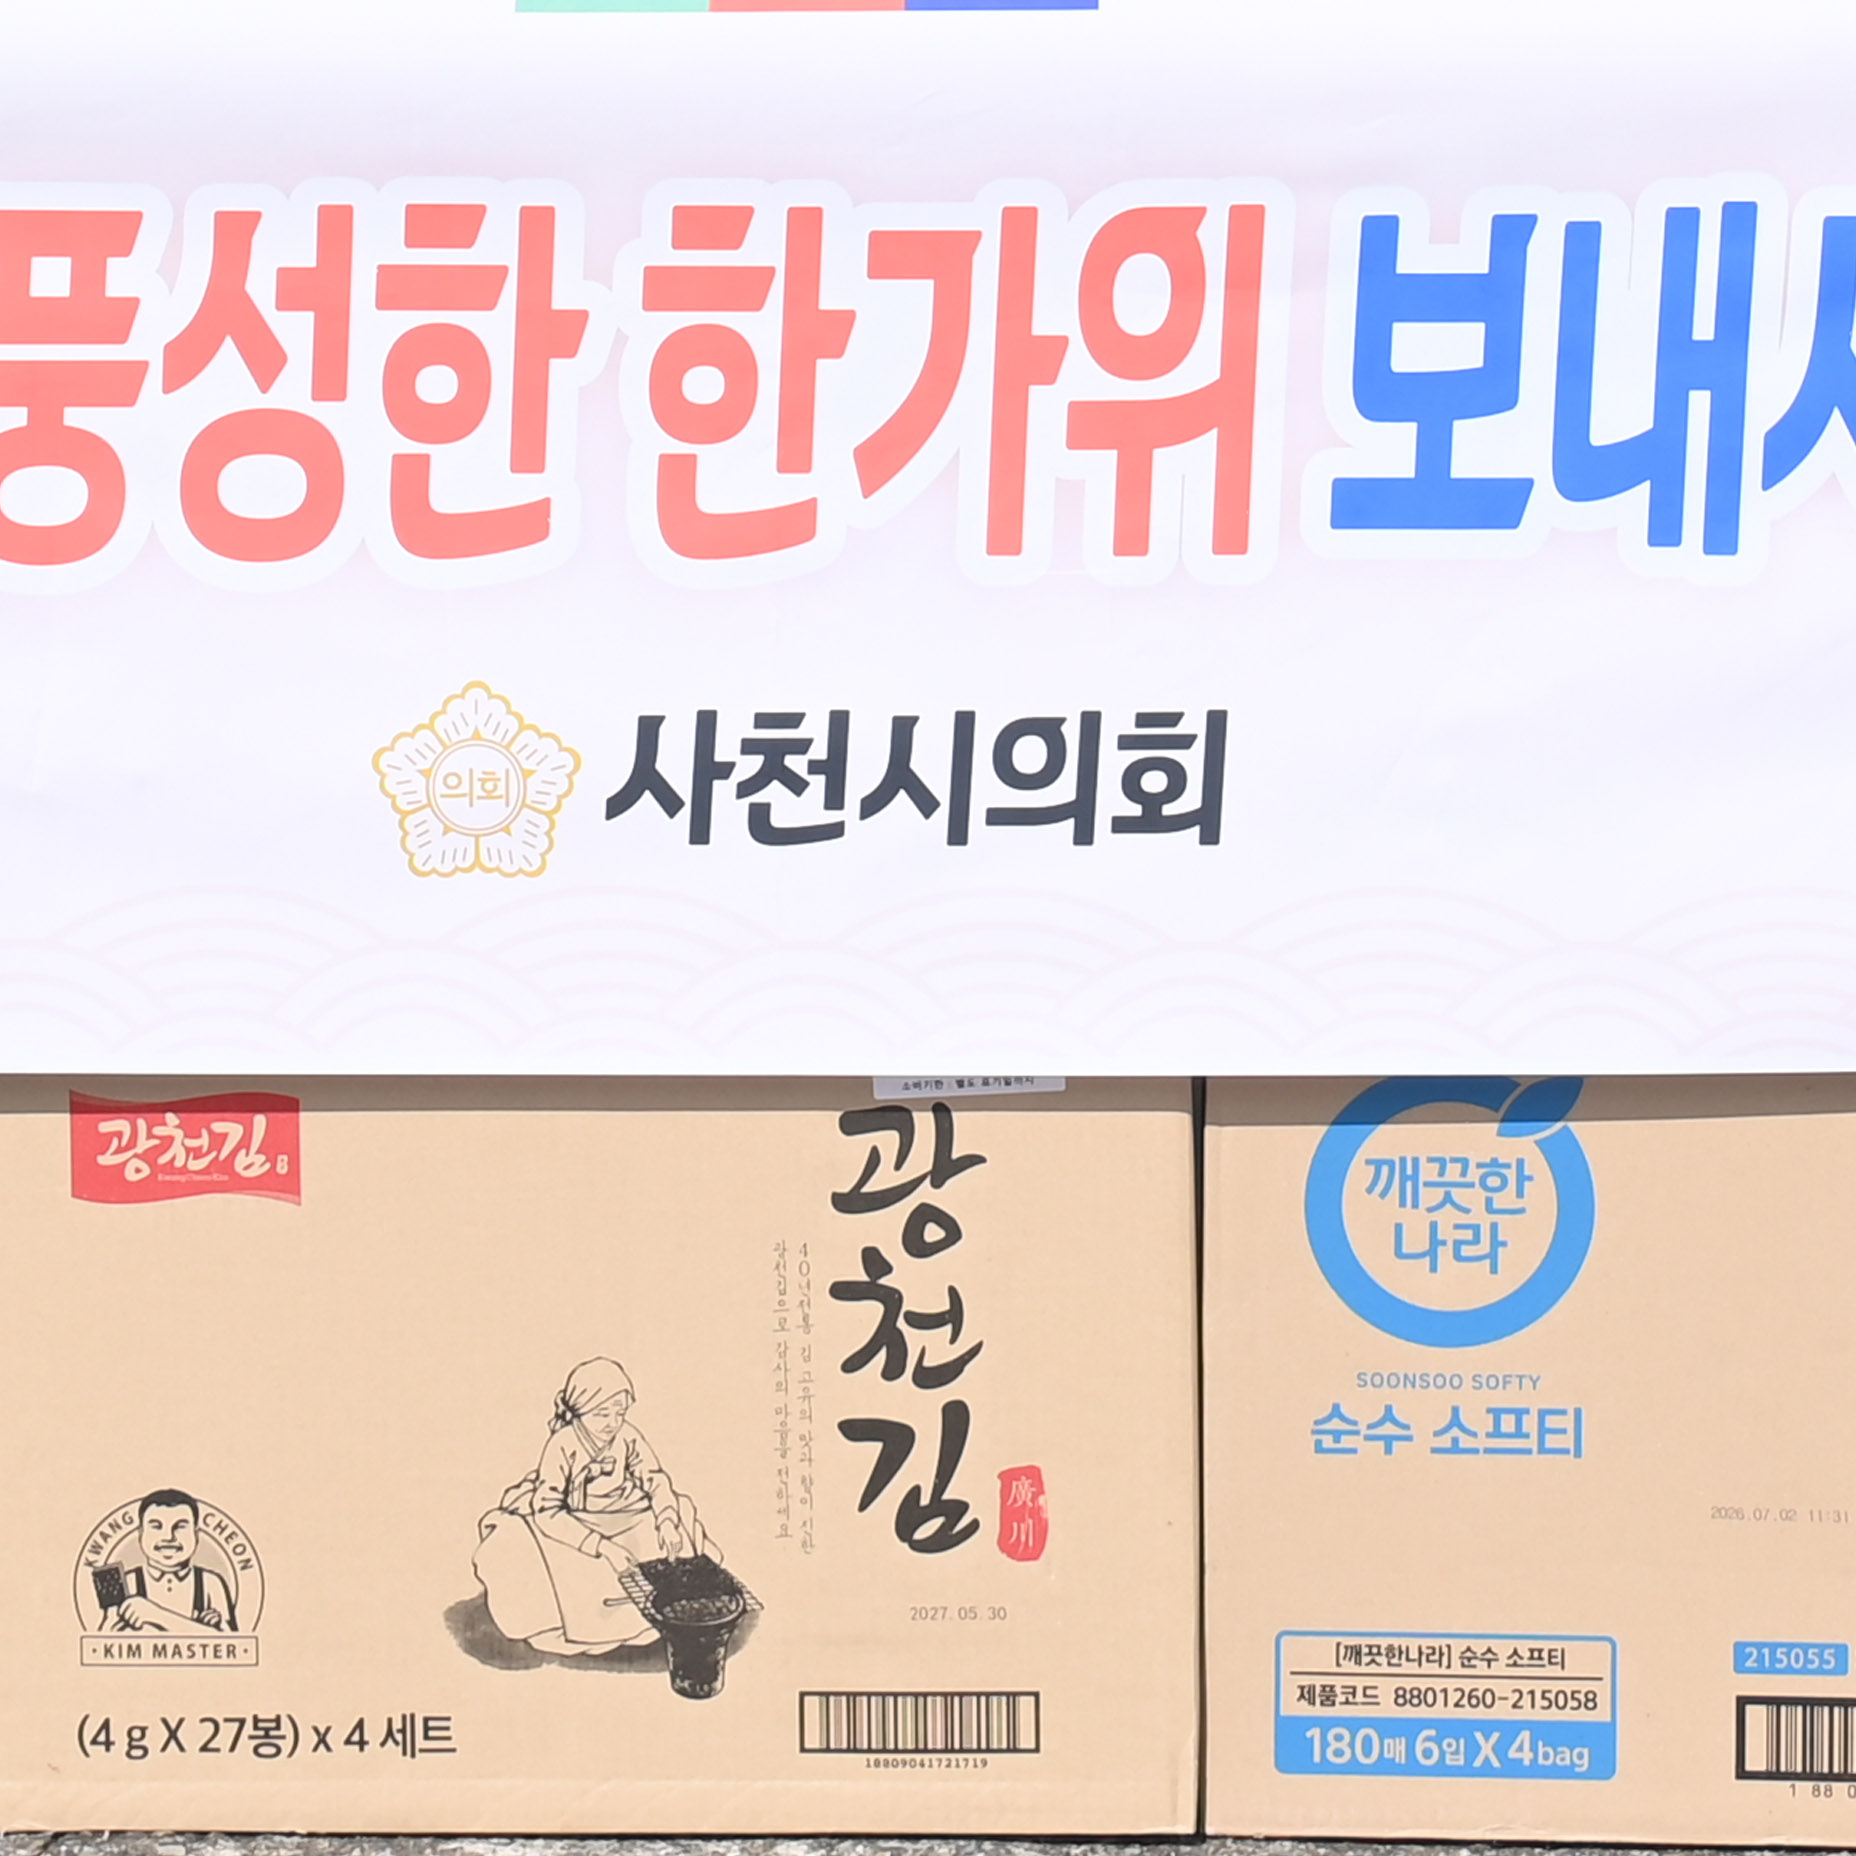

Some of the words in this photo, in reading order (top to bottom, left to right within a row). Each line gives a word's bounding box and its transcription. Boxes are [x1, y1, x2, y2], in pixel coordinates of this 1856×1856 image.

[640, 202, 1267, 562] 한가위
[438, 766, 522, 805] 의회
[604, 706, 1229, 848] 사천시의회
[97, 1112, 271, 1182] 광천김
[1364, 1155, 1534, 1216] 깨끗한
[1393, 1221, 1507, 1276] 나라
[829, 1102, 988, 1555] 광천김
[1356, 1372, 1464, 1392] SOONSOO
[1471, 1373, 1542, 1392] SOFTY
[1310, 1402, 1414, 1457] 순수
[1429, 1404, 1584, 1460] 소프티
[83, 1511, 134, 1568] KWANG
[203, 1512, 254, 1571] CHEON
[104, 1643, 141, 1659] KIM
[153, 1643, 237, 1659] MASTER
[1335, 1642, 1452, 1669] [깨끗한나라]
[1458, 1646, 1499, 1669] 순수
[1505, 1647, 1566, 1670] 소프티
[1744, 1647, 1836, 1669] 215055
[1296, 1684, 1381, 1707] 제품코드
[1393, 1687, 1598, 1711] 8801260-215058
[198, 1713, 301, 1760] 27봉)
[343, 1718, 369, 1753] 4
[379, 1714, 457, 1760] 세트
[865, 1758, 988, 1769] 18809041721719
